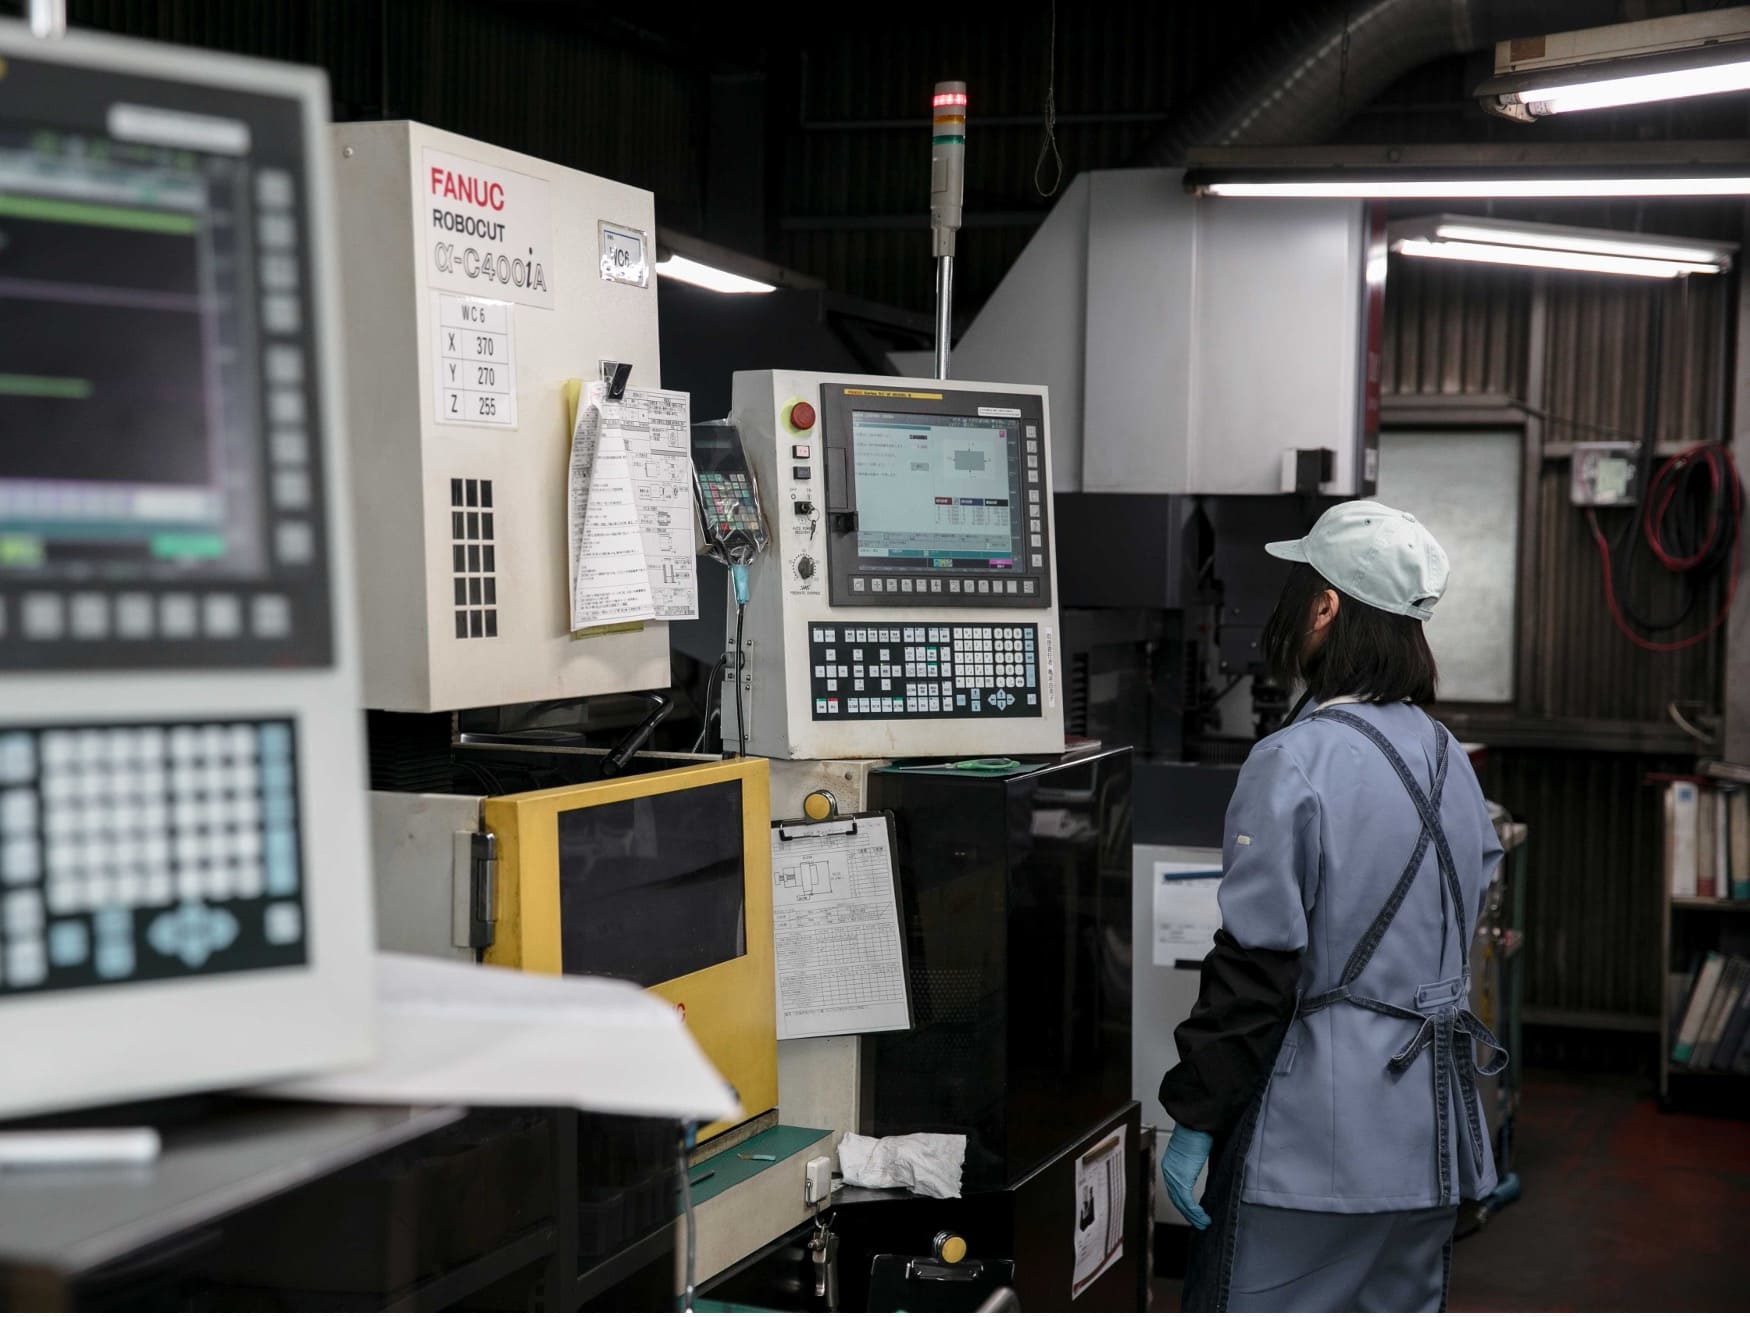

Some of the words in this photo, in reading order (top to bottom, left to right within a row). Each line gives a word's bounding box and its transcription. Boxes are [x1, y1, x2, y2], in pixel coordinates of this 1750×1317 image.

[431, 166, 505, 212] FANUC
[433, 208, 506, 243] ROBOCUT
[448, 332, 456, 352] X
[476, 336, 494, 356] 370
[449, 363, 457, 382] Y
[478, 367, 495, 386] 270
[451, 394, 459, 413] Z
[479, 397, 496, 416] 255
